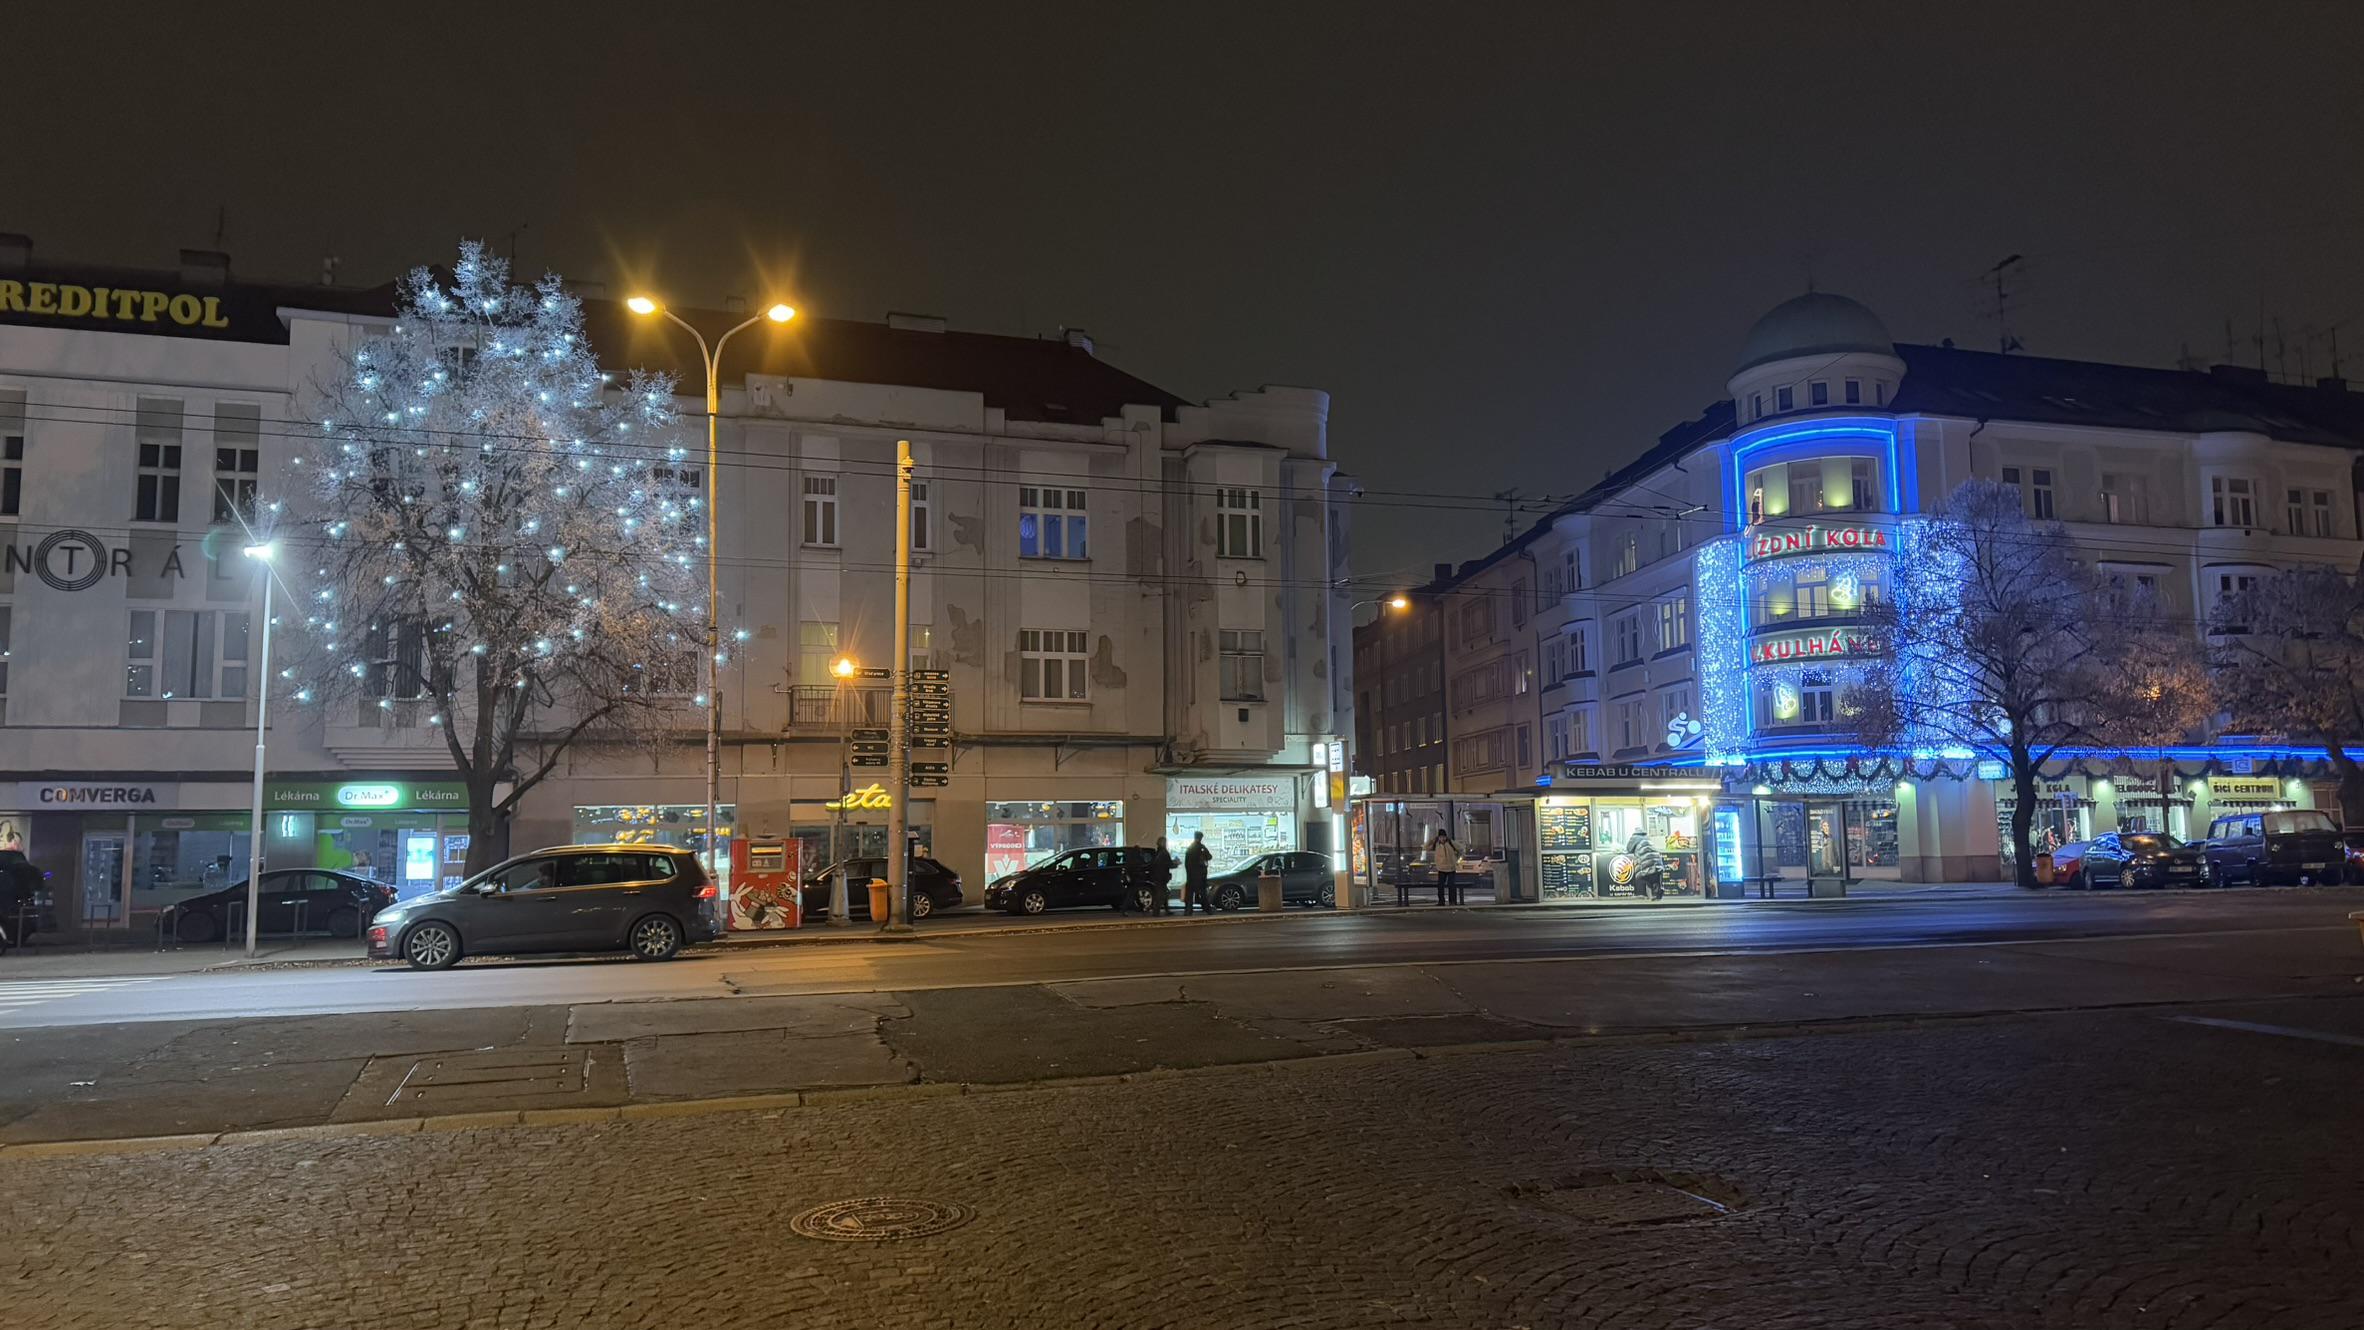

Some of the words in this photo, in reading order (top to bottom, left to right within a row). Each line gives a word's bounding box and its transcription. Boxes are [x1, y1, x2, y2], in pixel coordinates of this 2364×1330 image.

[0, 280, 229, 328] REDITPOL
[1825, 529, 1886, 547] KOLA
[1566, 767, 1616, 777] KEBAB
[1618, 767, 1628, 777] U
[1631, 766, 1705, 777] CENTRALU
[1179, 782, 1219, 794] ITALSKÉ
[1221, 783, 1278, 794] DELIKATESY
[2046, 784, 2071, 793] KOLA
[2234, 784, 2274, 794] CENTRUM
[40, 787, 156, 803] COMVERGA
[274, 790, 320, 801] Lékárna
[415, 789, 460, 801] Lékárna
[825, 783, 893, 808] eta
[1212, 796, 1246, 804] SPECIALITY
[1609, 883, 1635, 892] Kebab
